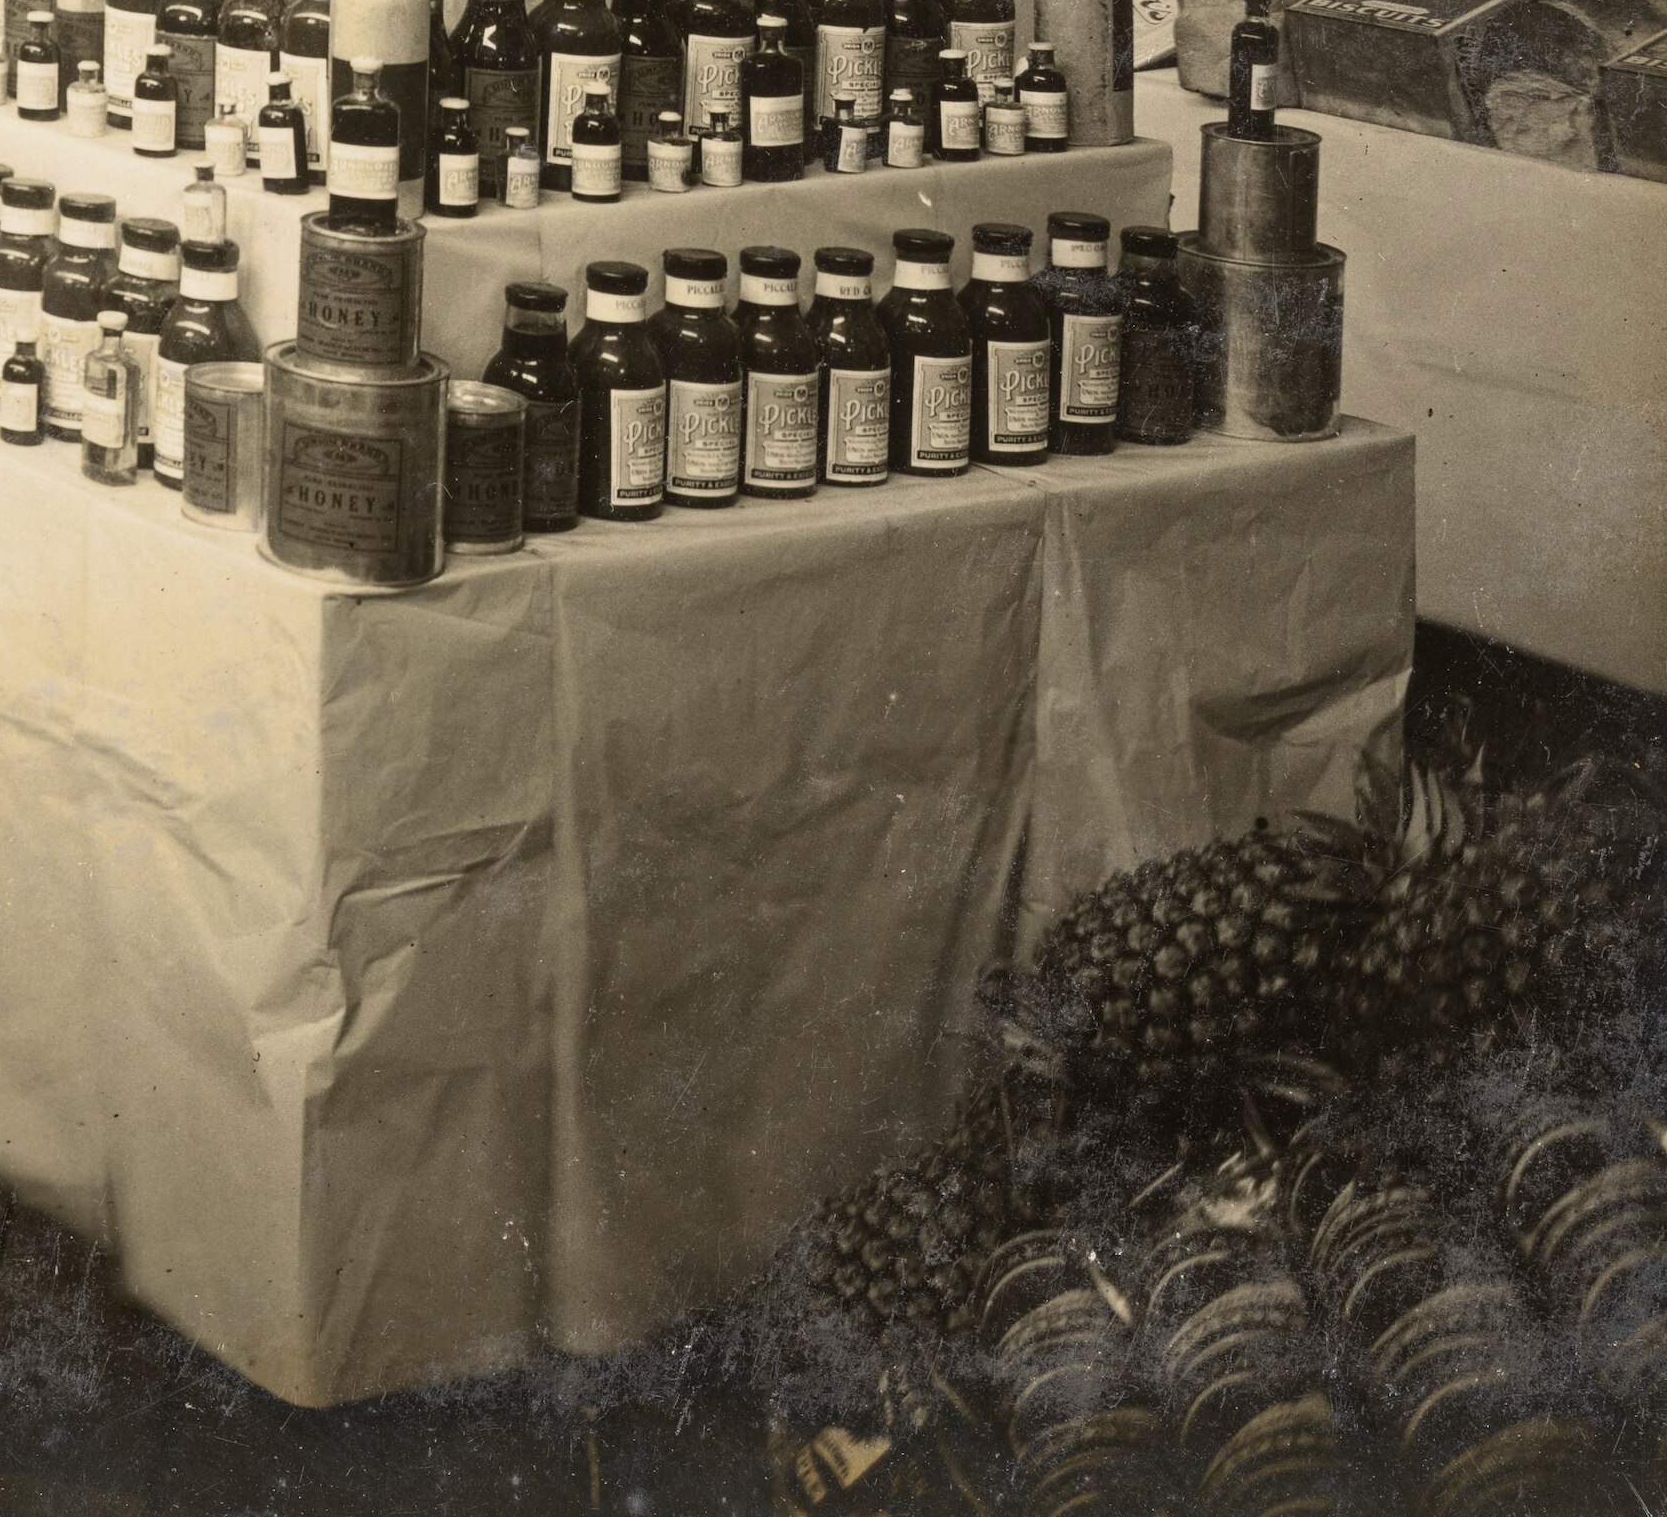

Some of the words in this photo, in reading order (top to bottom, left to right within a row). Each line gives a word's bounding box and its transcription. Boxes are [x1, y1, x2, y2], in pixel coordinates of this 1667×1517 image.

[840, 287, 860, 296] RED
[309, 301, 381, 328] HONEY
[1069, 407, 1099, 416] PURITY
[620, 490, 647, 498] PURITY
[299, 486, 376, 513] HONEY
